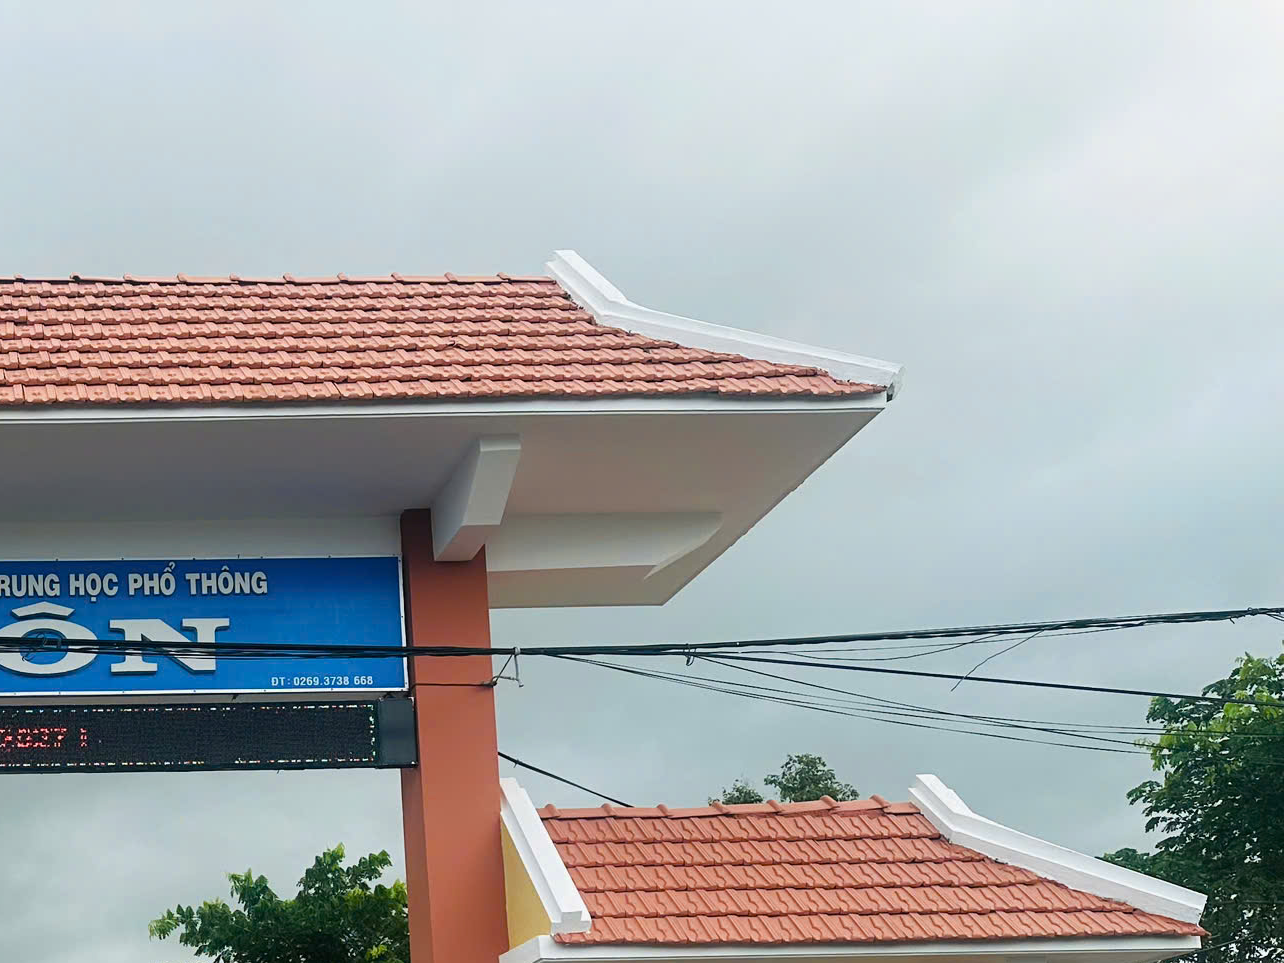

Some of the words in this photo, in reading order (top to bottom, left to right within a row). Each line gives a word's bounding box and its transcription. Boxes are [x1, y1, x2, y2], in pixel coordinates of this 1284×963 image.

[69, 573, 119, 603] HỌC
[128, 560, 177, 597] PHỔ
[185, 566, 269, 595] THÔNG
[293, 675, 350, 686] 0269.3738
[353, 674, 374, 686] 668
